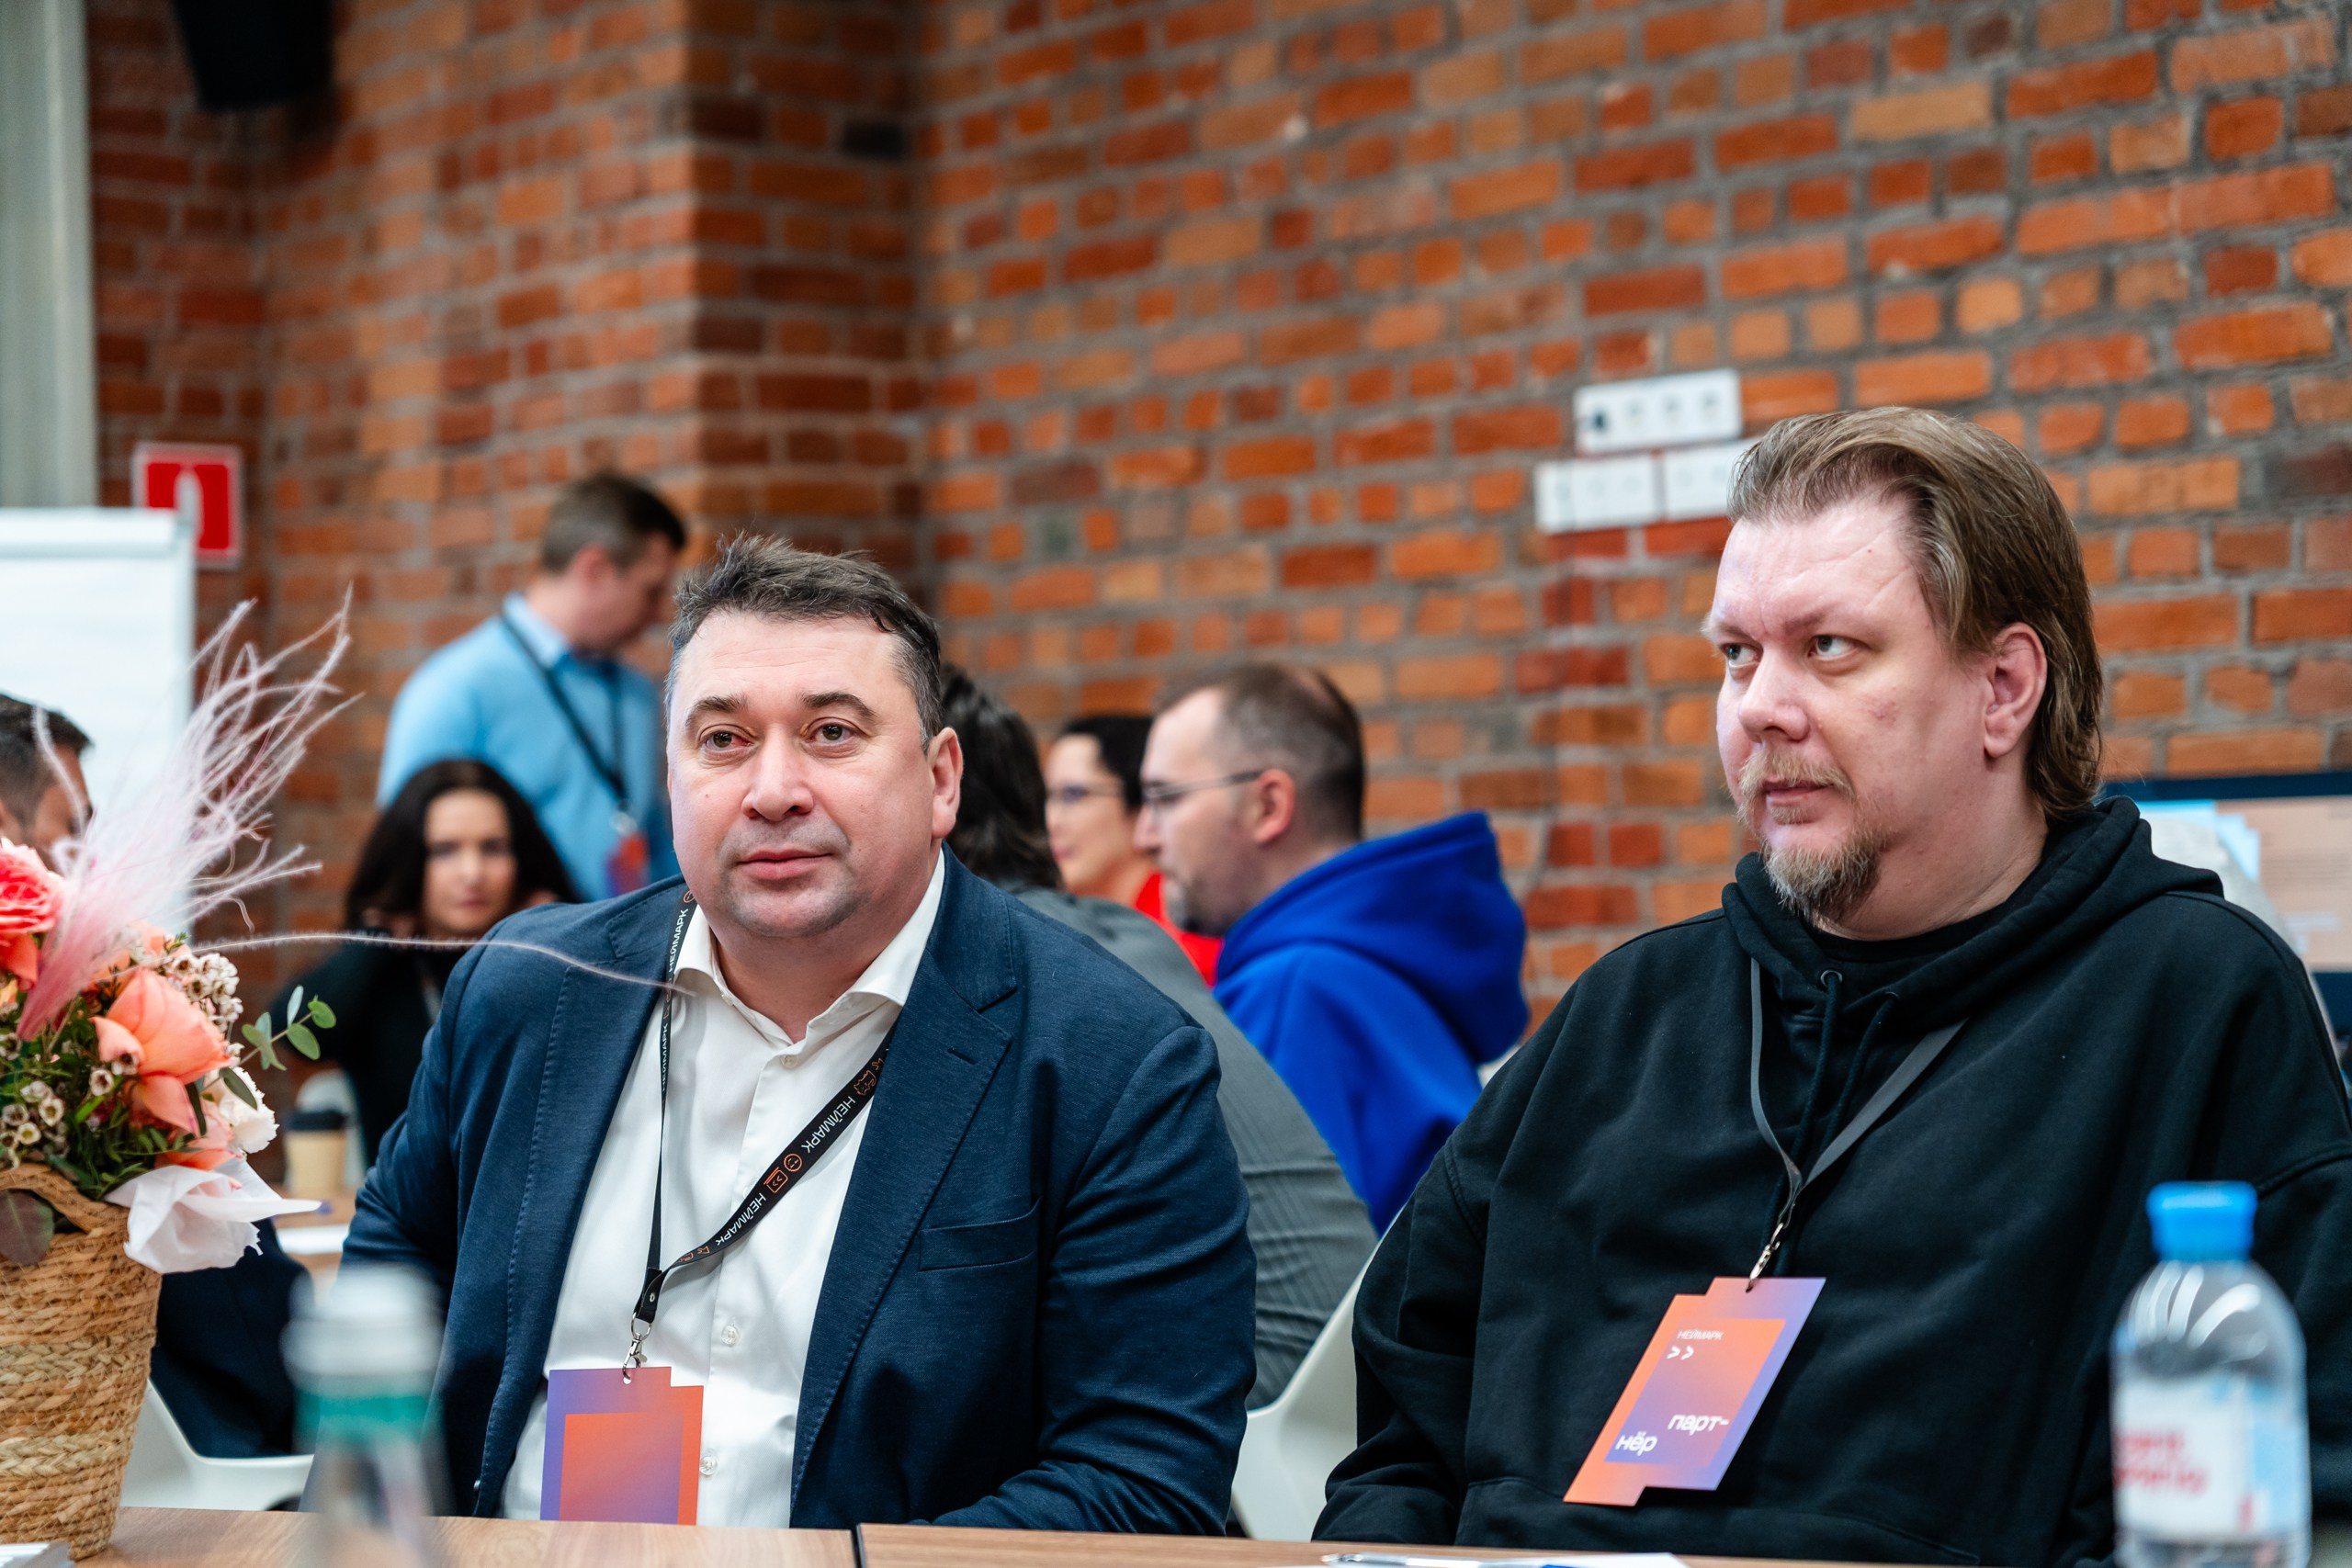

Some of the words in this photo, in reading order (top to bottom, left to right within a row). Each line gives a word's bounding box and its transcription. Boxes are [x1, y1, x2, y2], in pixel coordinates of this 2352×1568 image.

[669, 908, 688, 973] НЕЙМАРК
[801, 1096, 855, 1153] НЕЙМАРК
[716, 1192, 766, 1246] НЕЙМАРК
[1677, 1328, 1724, 1340] НЕЙМАРК
[1614, 1431, 1657, 1456] нёр
[1668, 1415, 1729, 1436] парт-
